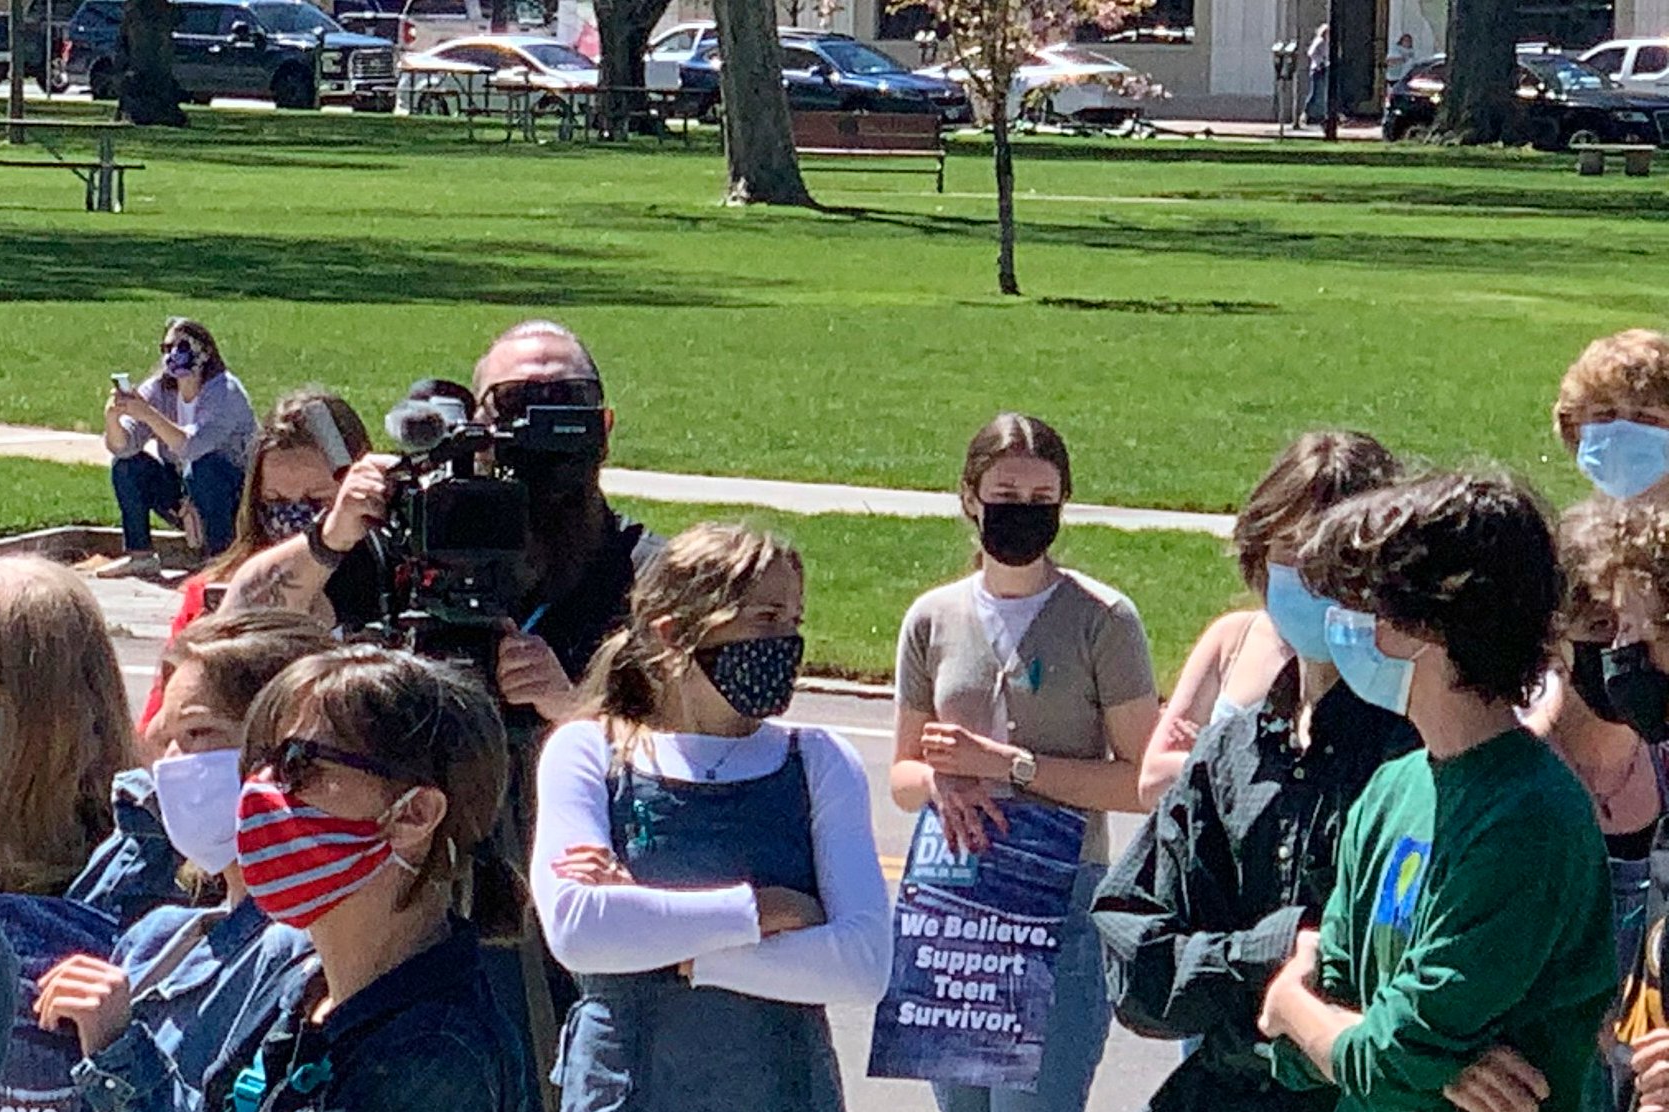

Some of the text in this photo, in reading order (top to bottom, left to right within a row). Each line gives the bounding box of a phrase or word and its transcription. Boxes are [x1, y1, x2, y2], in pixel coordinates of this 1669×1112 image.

[901, 913, 1056, 947] We Believe.
[915, 946, 1026, 976] Support
[934, 976, 996, 1001] Teen
[898, 1002, 1022, 1032] Survivor.
